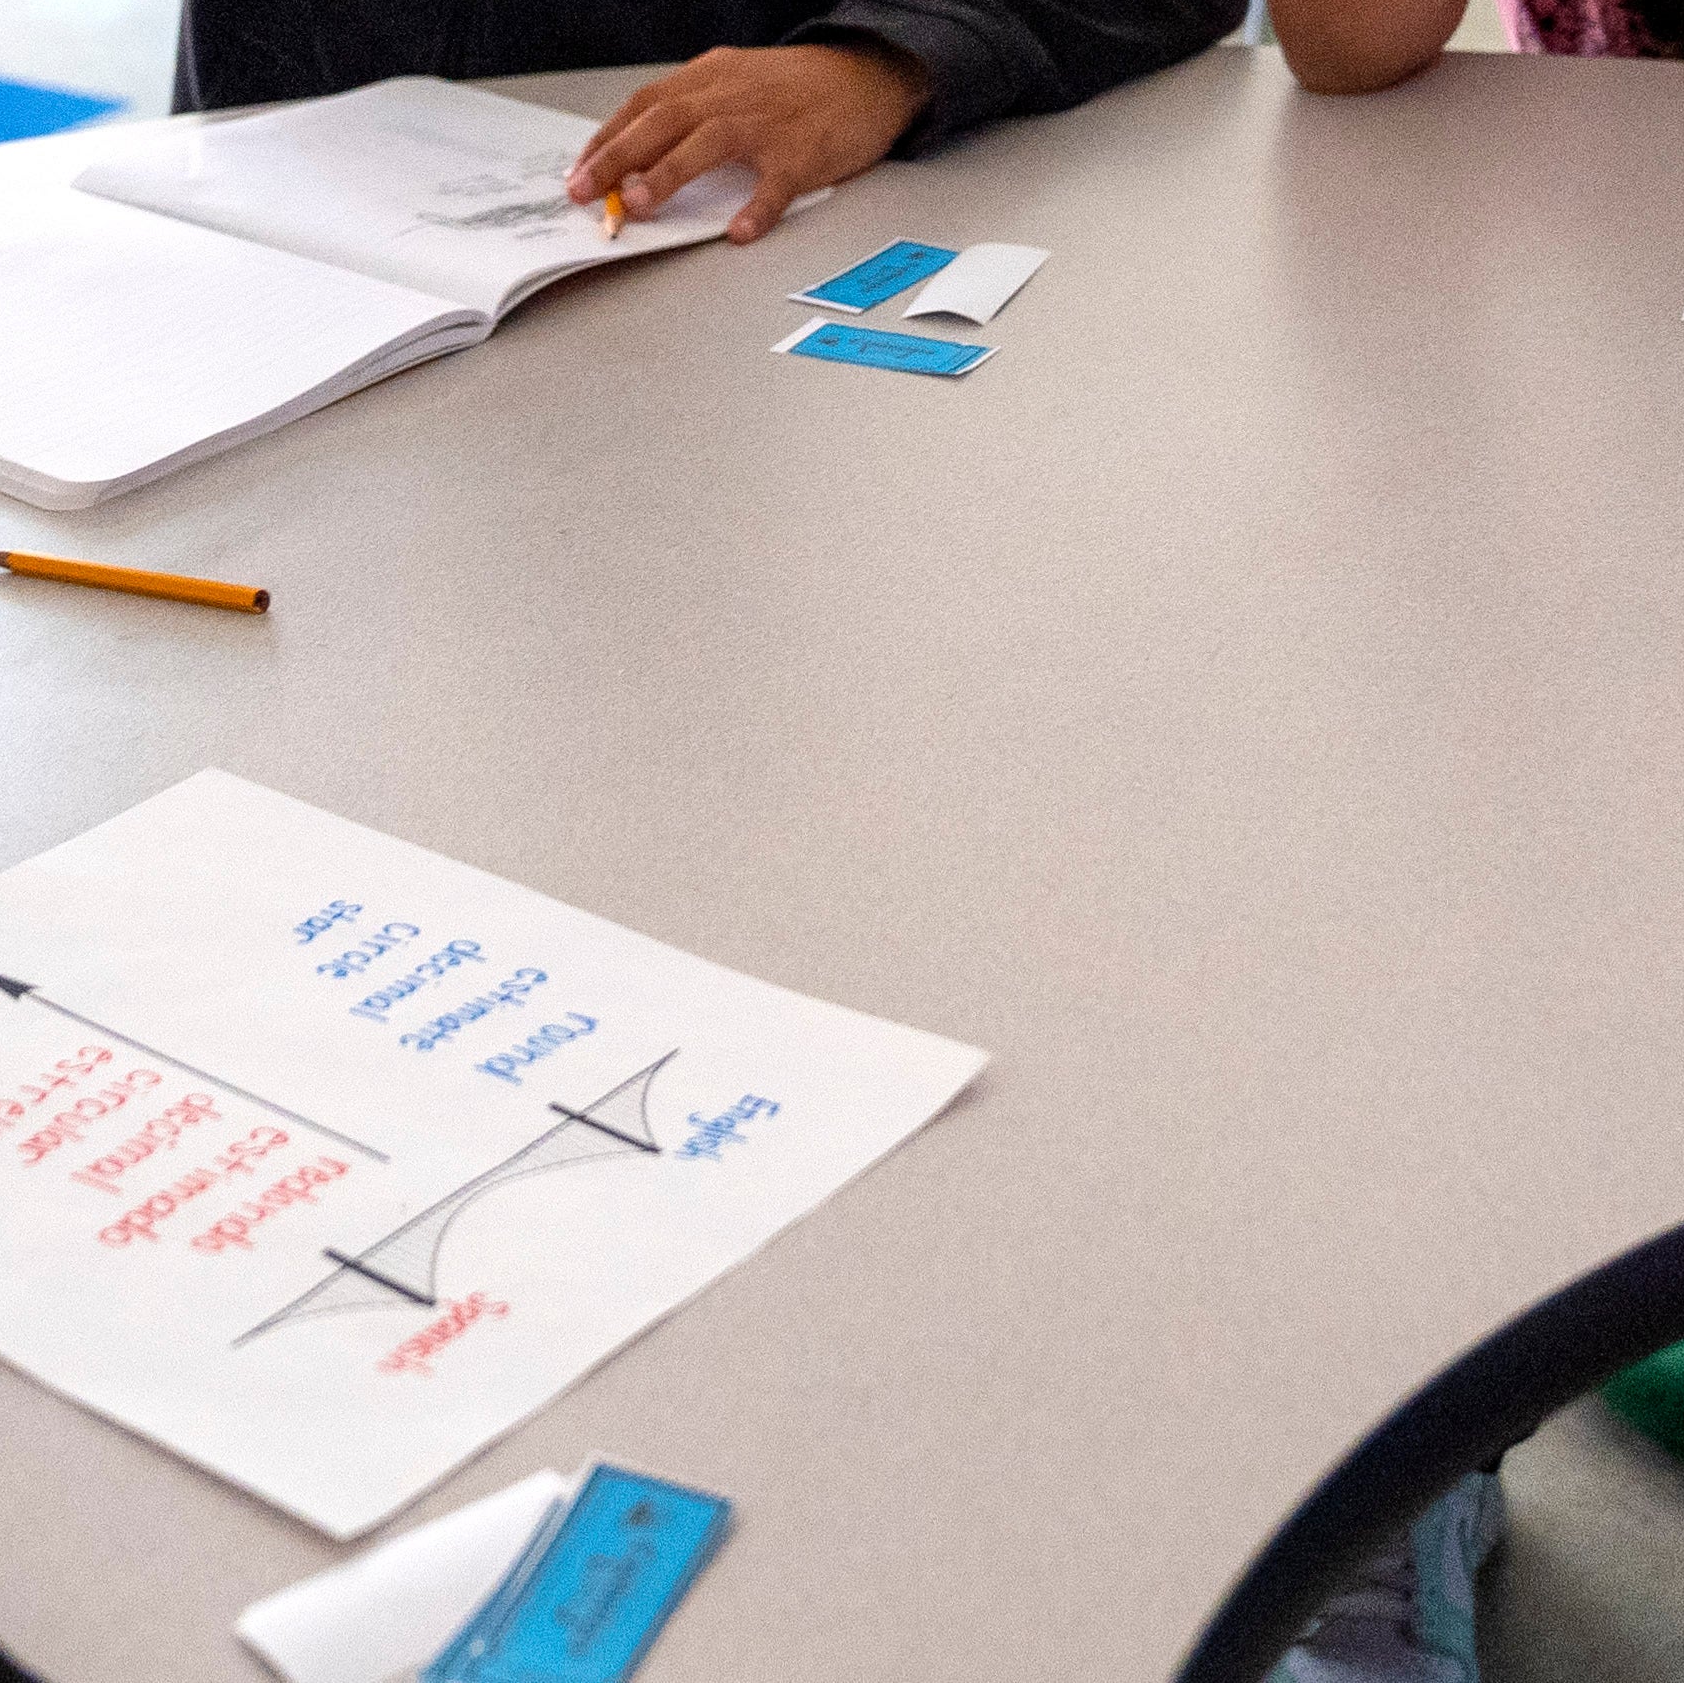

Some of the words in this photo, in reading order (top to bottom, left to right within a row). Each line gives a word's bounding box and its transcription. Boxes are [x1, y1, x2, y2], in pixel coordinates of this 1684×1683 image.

[293, 899, 364, 945] star
[316, 921, 421, 979] circle
[349, 939, 488, 1024] decimal
[398, 966, 548, 1052] estimate
[474, 1011, 600, 1085] round
[15, 1069, 163, 1168] circular
[70, 1092, 221, 1196] decimal
[675, 1093, 781, 1162] English
[97, 1125, 290, 1248] estimado
[189, 1155, 351, 1253] redondo
[375, 1290, 511, 1380] Spanish
